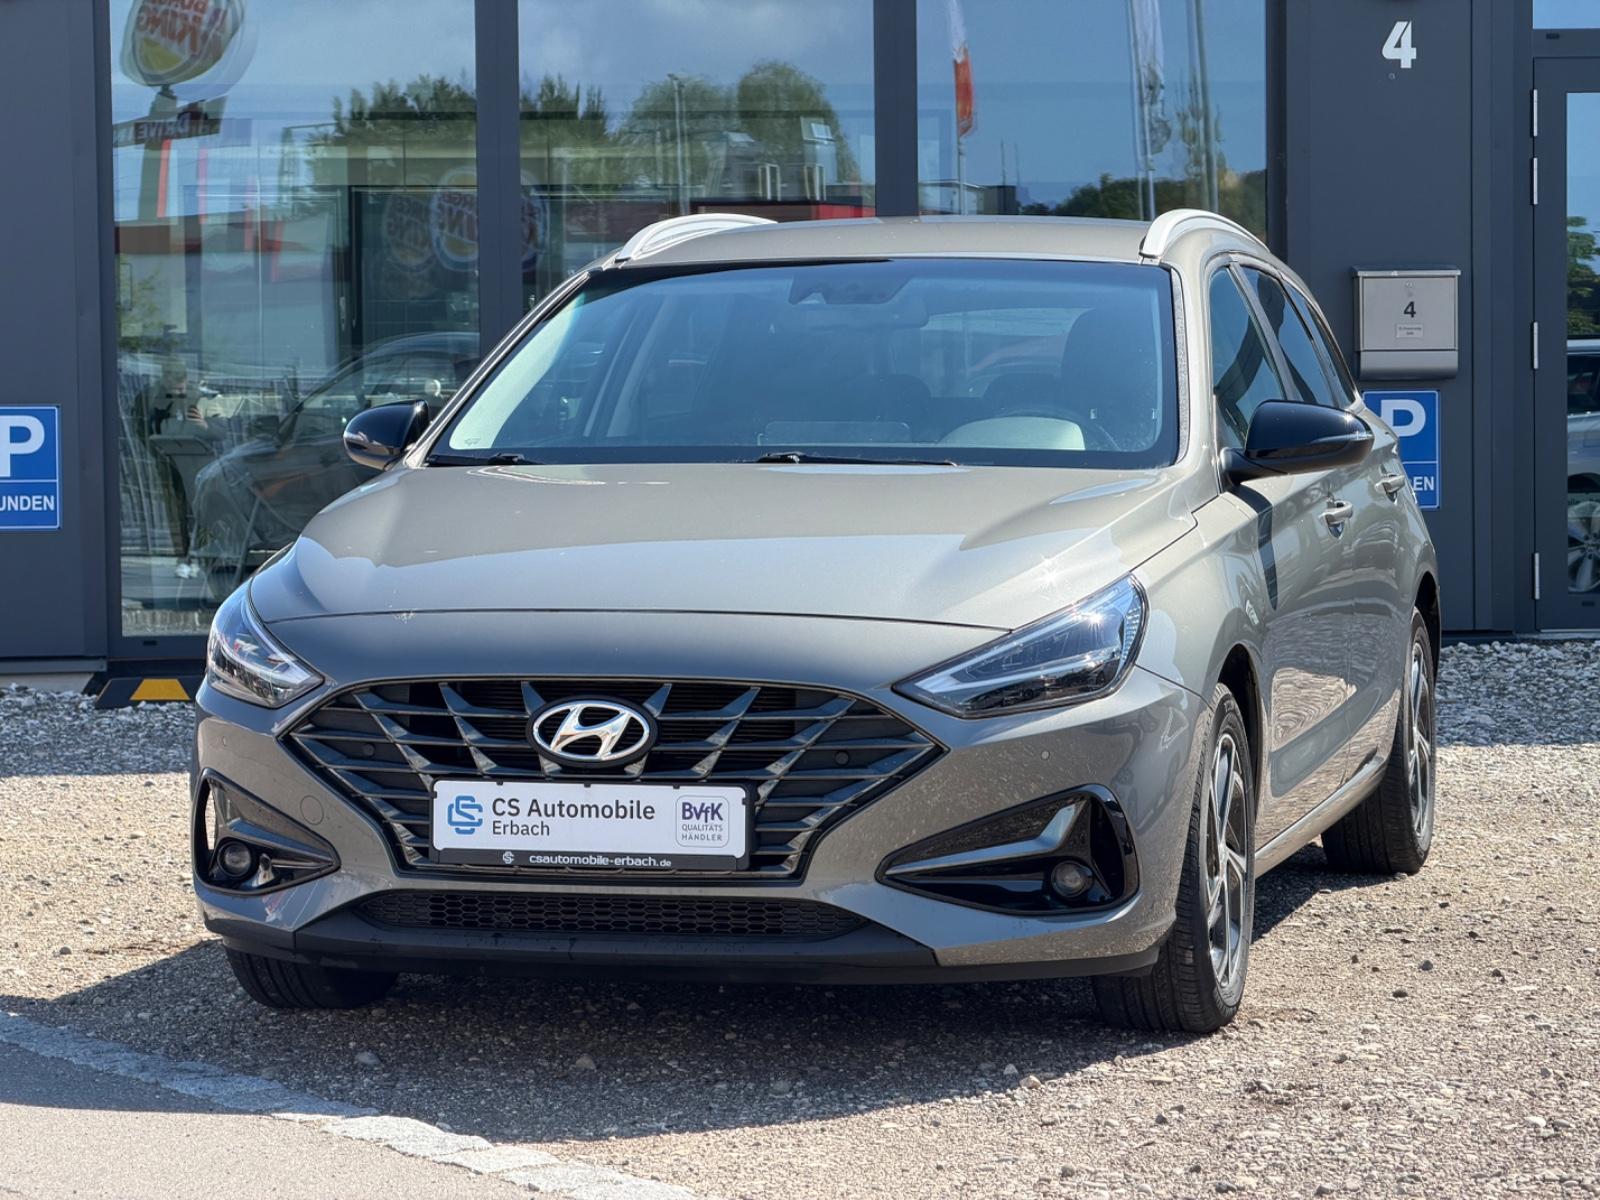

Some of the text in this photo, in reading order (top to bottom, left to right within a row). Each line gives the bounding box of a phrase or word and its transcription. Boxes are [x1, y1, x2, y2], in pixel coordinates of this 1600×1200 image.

[1382, 20, 1417, 69] 4
[1403, 301, 1417, 318] 4
[1381, 399, 1426, 437] P
[0, 415, 45, 477] P
[1412, 475, 1435, 491] EN
[492, 797, 656, 820] CS Automobile
[492, 820, 550, 837] Erbach
[529, 854, 672, 867] csautomobile-erbach.de
